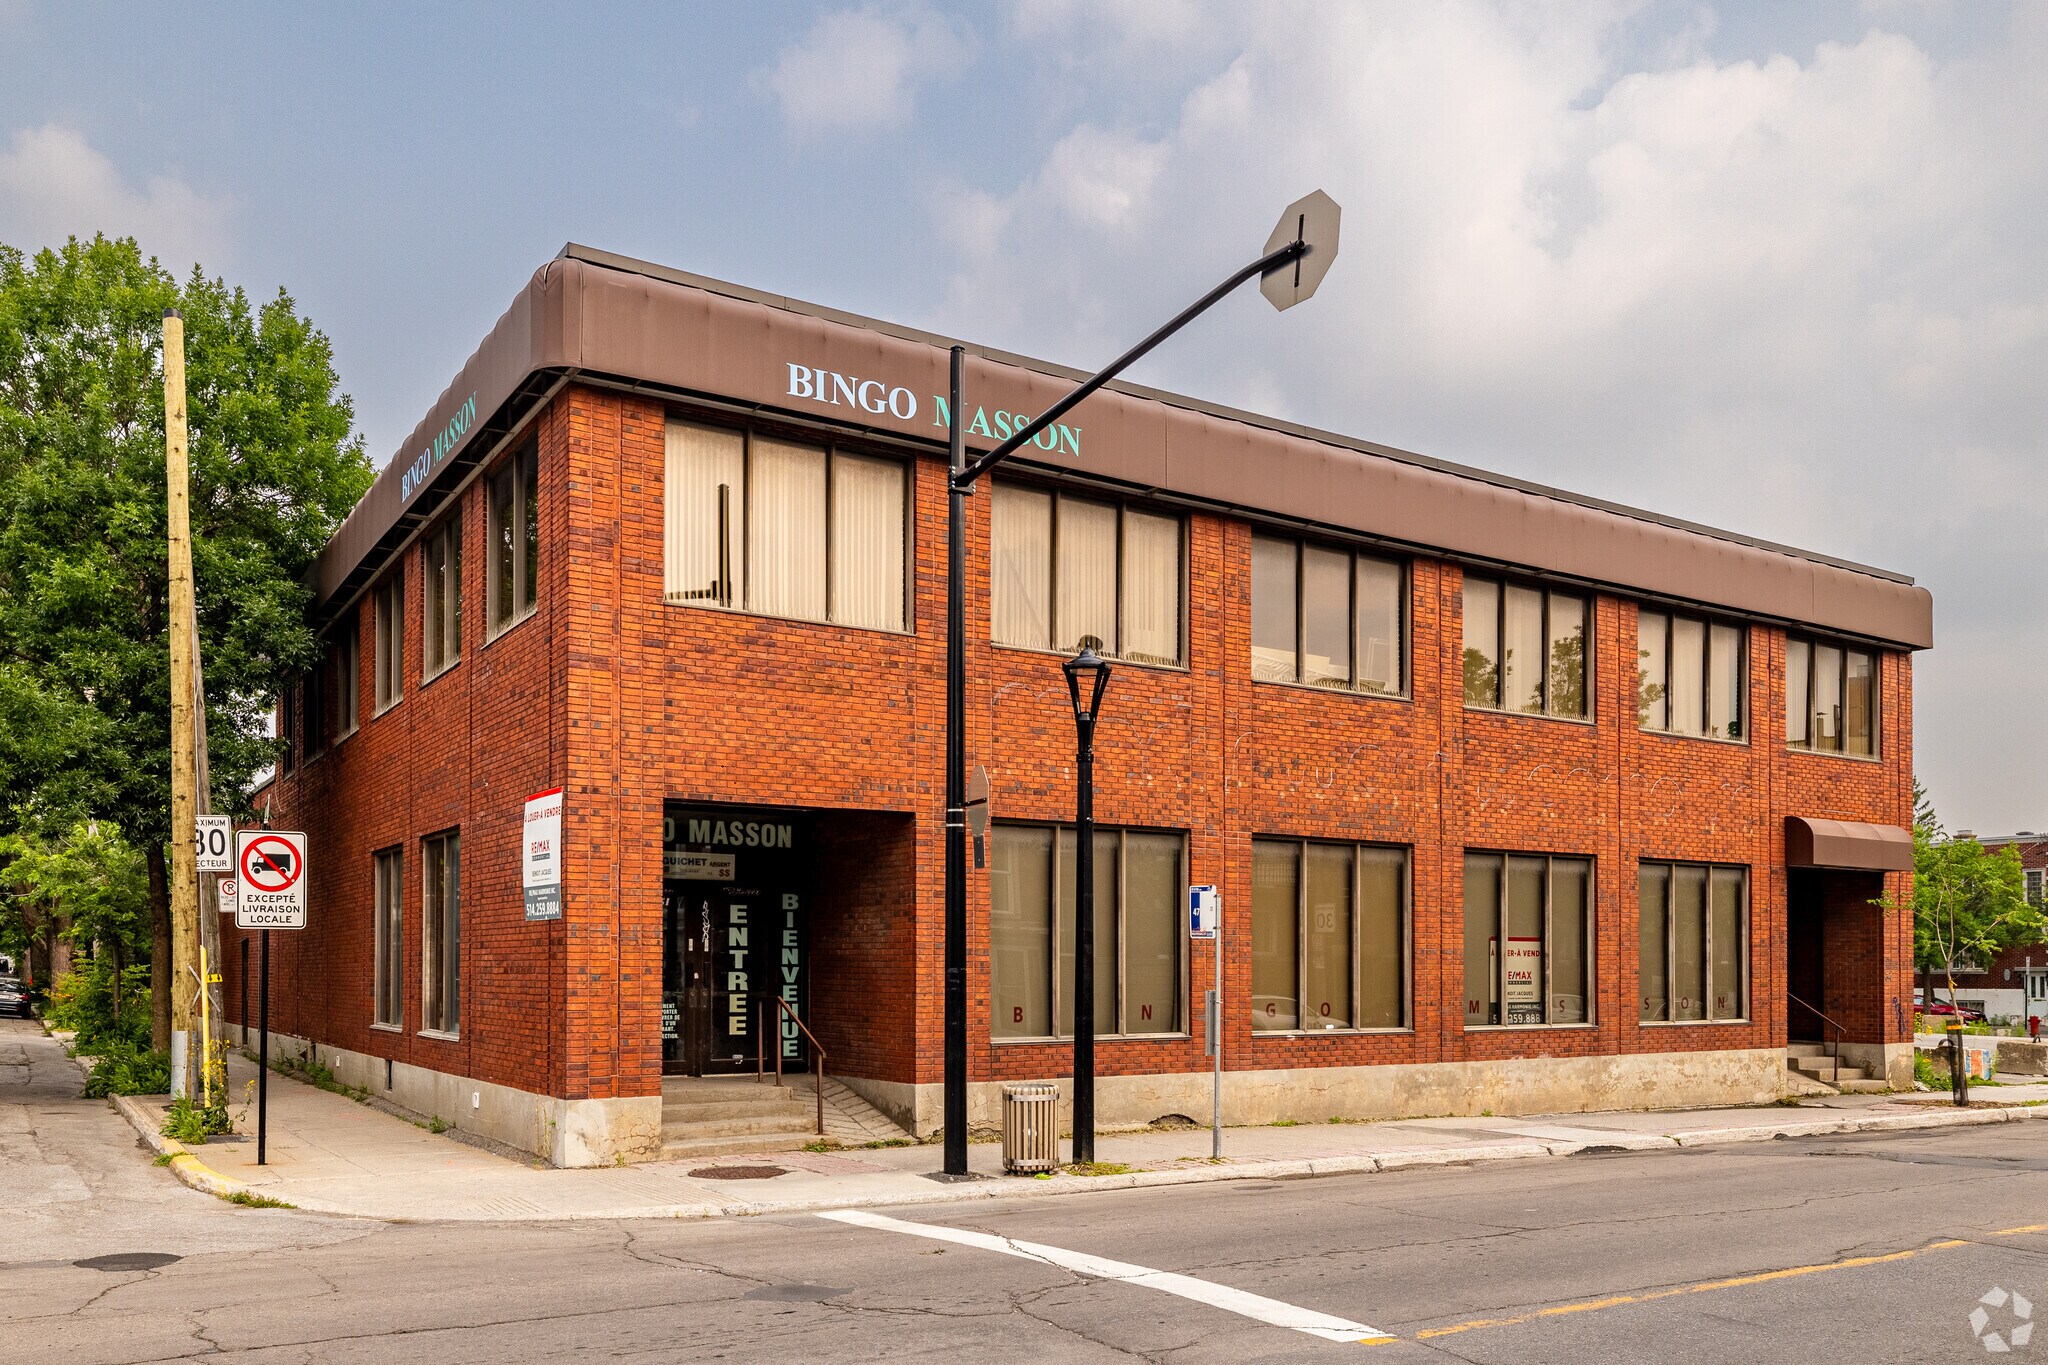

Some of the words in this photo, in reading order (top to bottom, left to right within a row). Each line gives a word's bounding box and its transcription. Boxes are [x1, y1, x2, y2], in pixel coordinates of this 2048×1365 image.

[786, 362, 918, 420] BINGO
[402, 447, 431, 503] BINGO
[433, 391, 477, 467] MASSON
[195, 819, 226, 827] AXIMUM
[689, 819, 792, 848] MASSON
[663, 857, 707, 866] GUICHET
[247, 893, 296, 903] EXCEPTÉ
[242, 905, 300, 913] LIVRAISON
[1507, 948, 1521, 957] ER-À
[728, 904, 748, 1035] ENTREE
[781, 893, 800, 1057] BIENVENUE
[1508, 971, 1532, 980] E/MAX
